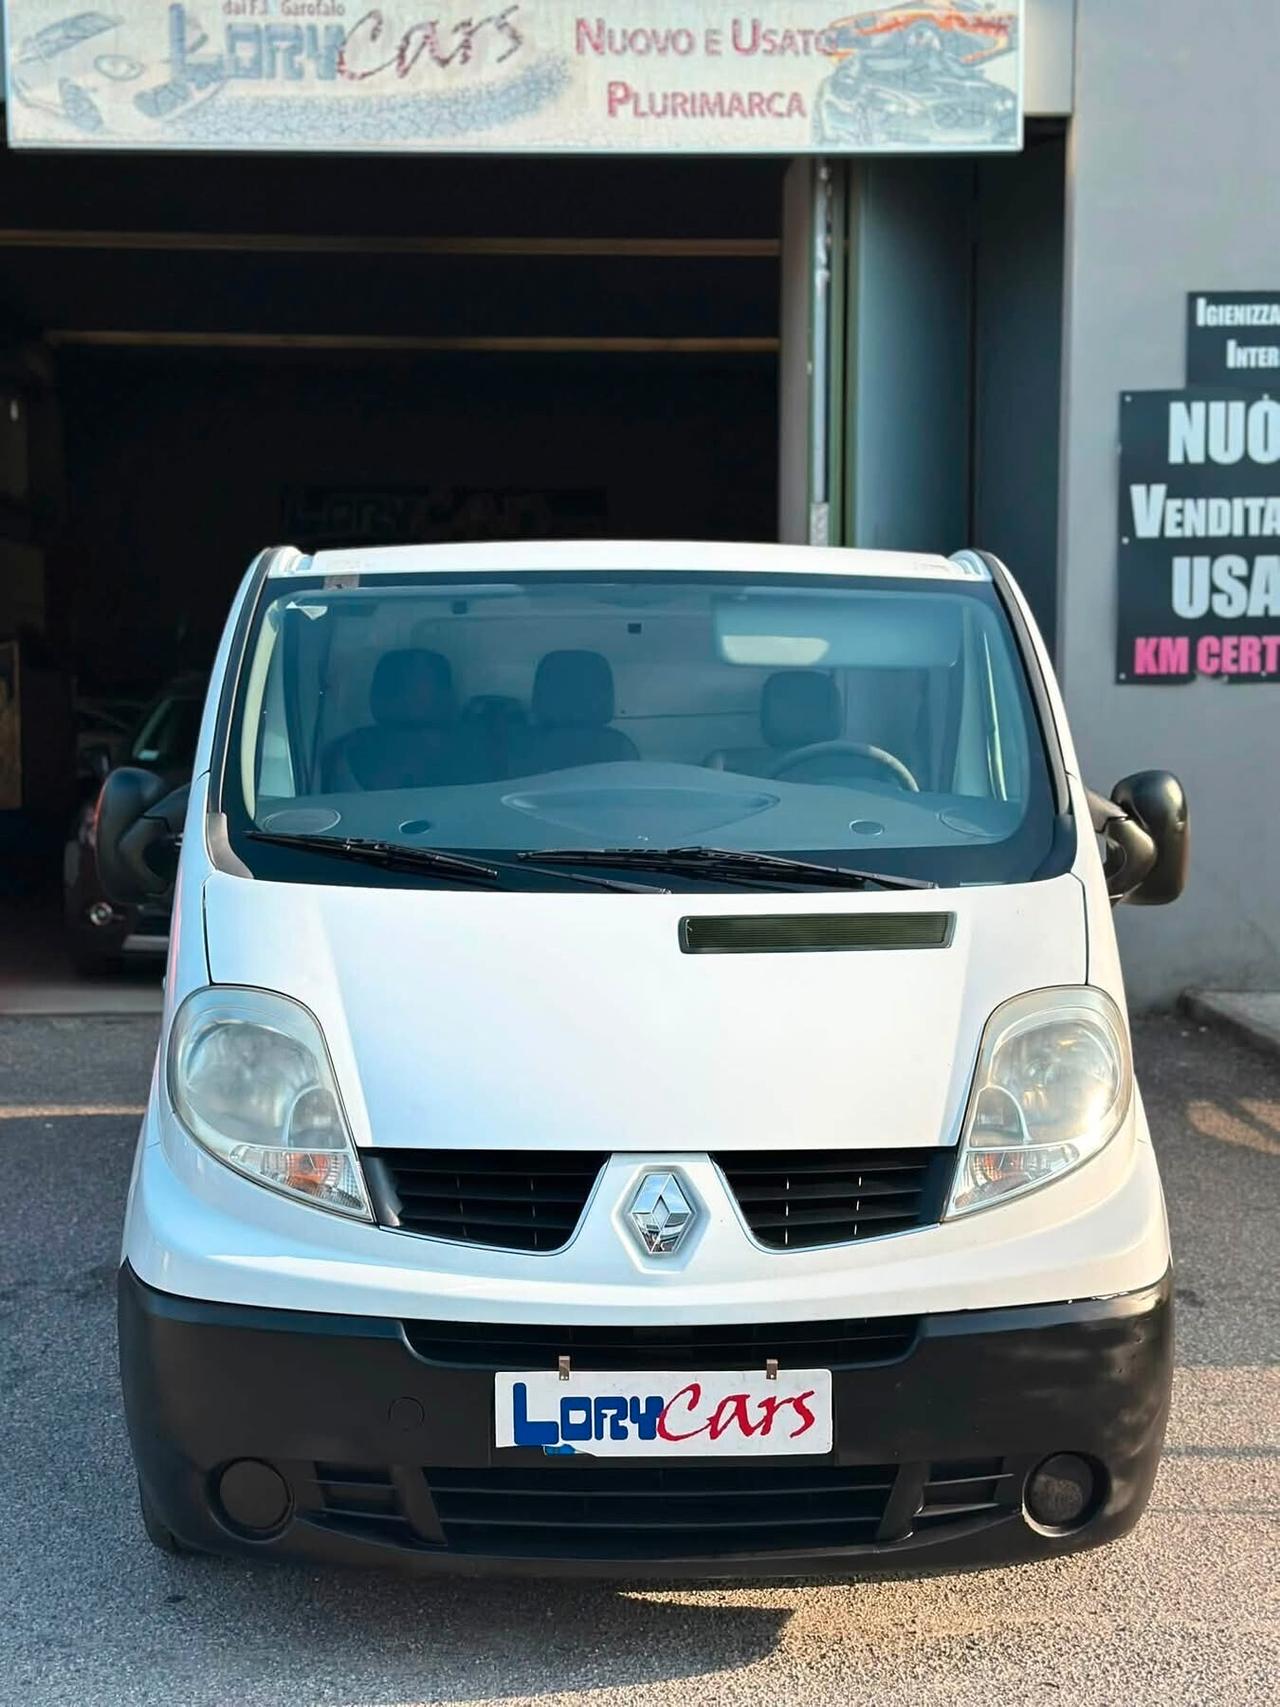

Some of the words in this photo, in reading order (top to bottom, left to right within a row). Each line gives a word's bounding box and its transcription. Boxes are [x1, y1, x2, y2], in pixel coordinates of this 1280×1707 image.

[575, 18, 695, 56] NUOVO
[704, 29, 722, 56] E
[731, 18, 838, 57] USATO
[606, 81, 807, 119] PLURIMARCA
[1130, 484, 1280, 539] VENDITA
[1172, 555, 1280, 619] USA
[1134, 637, 1190, 676] KM
[1198, 635, 1280, 676] CERT
